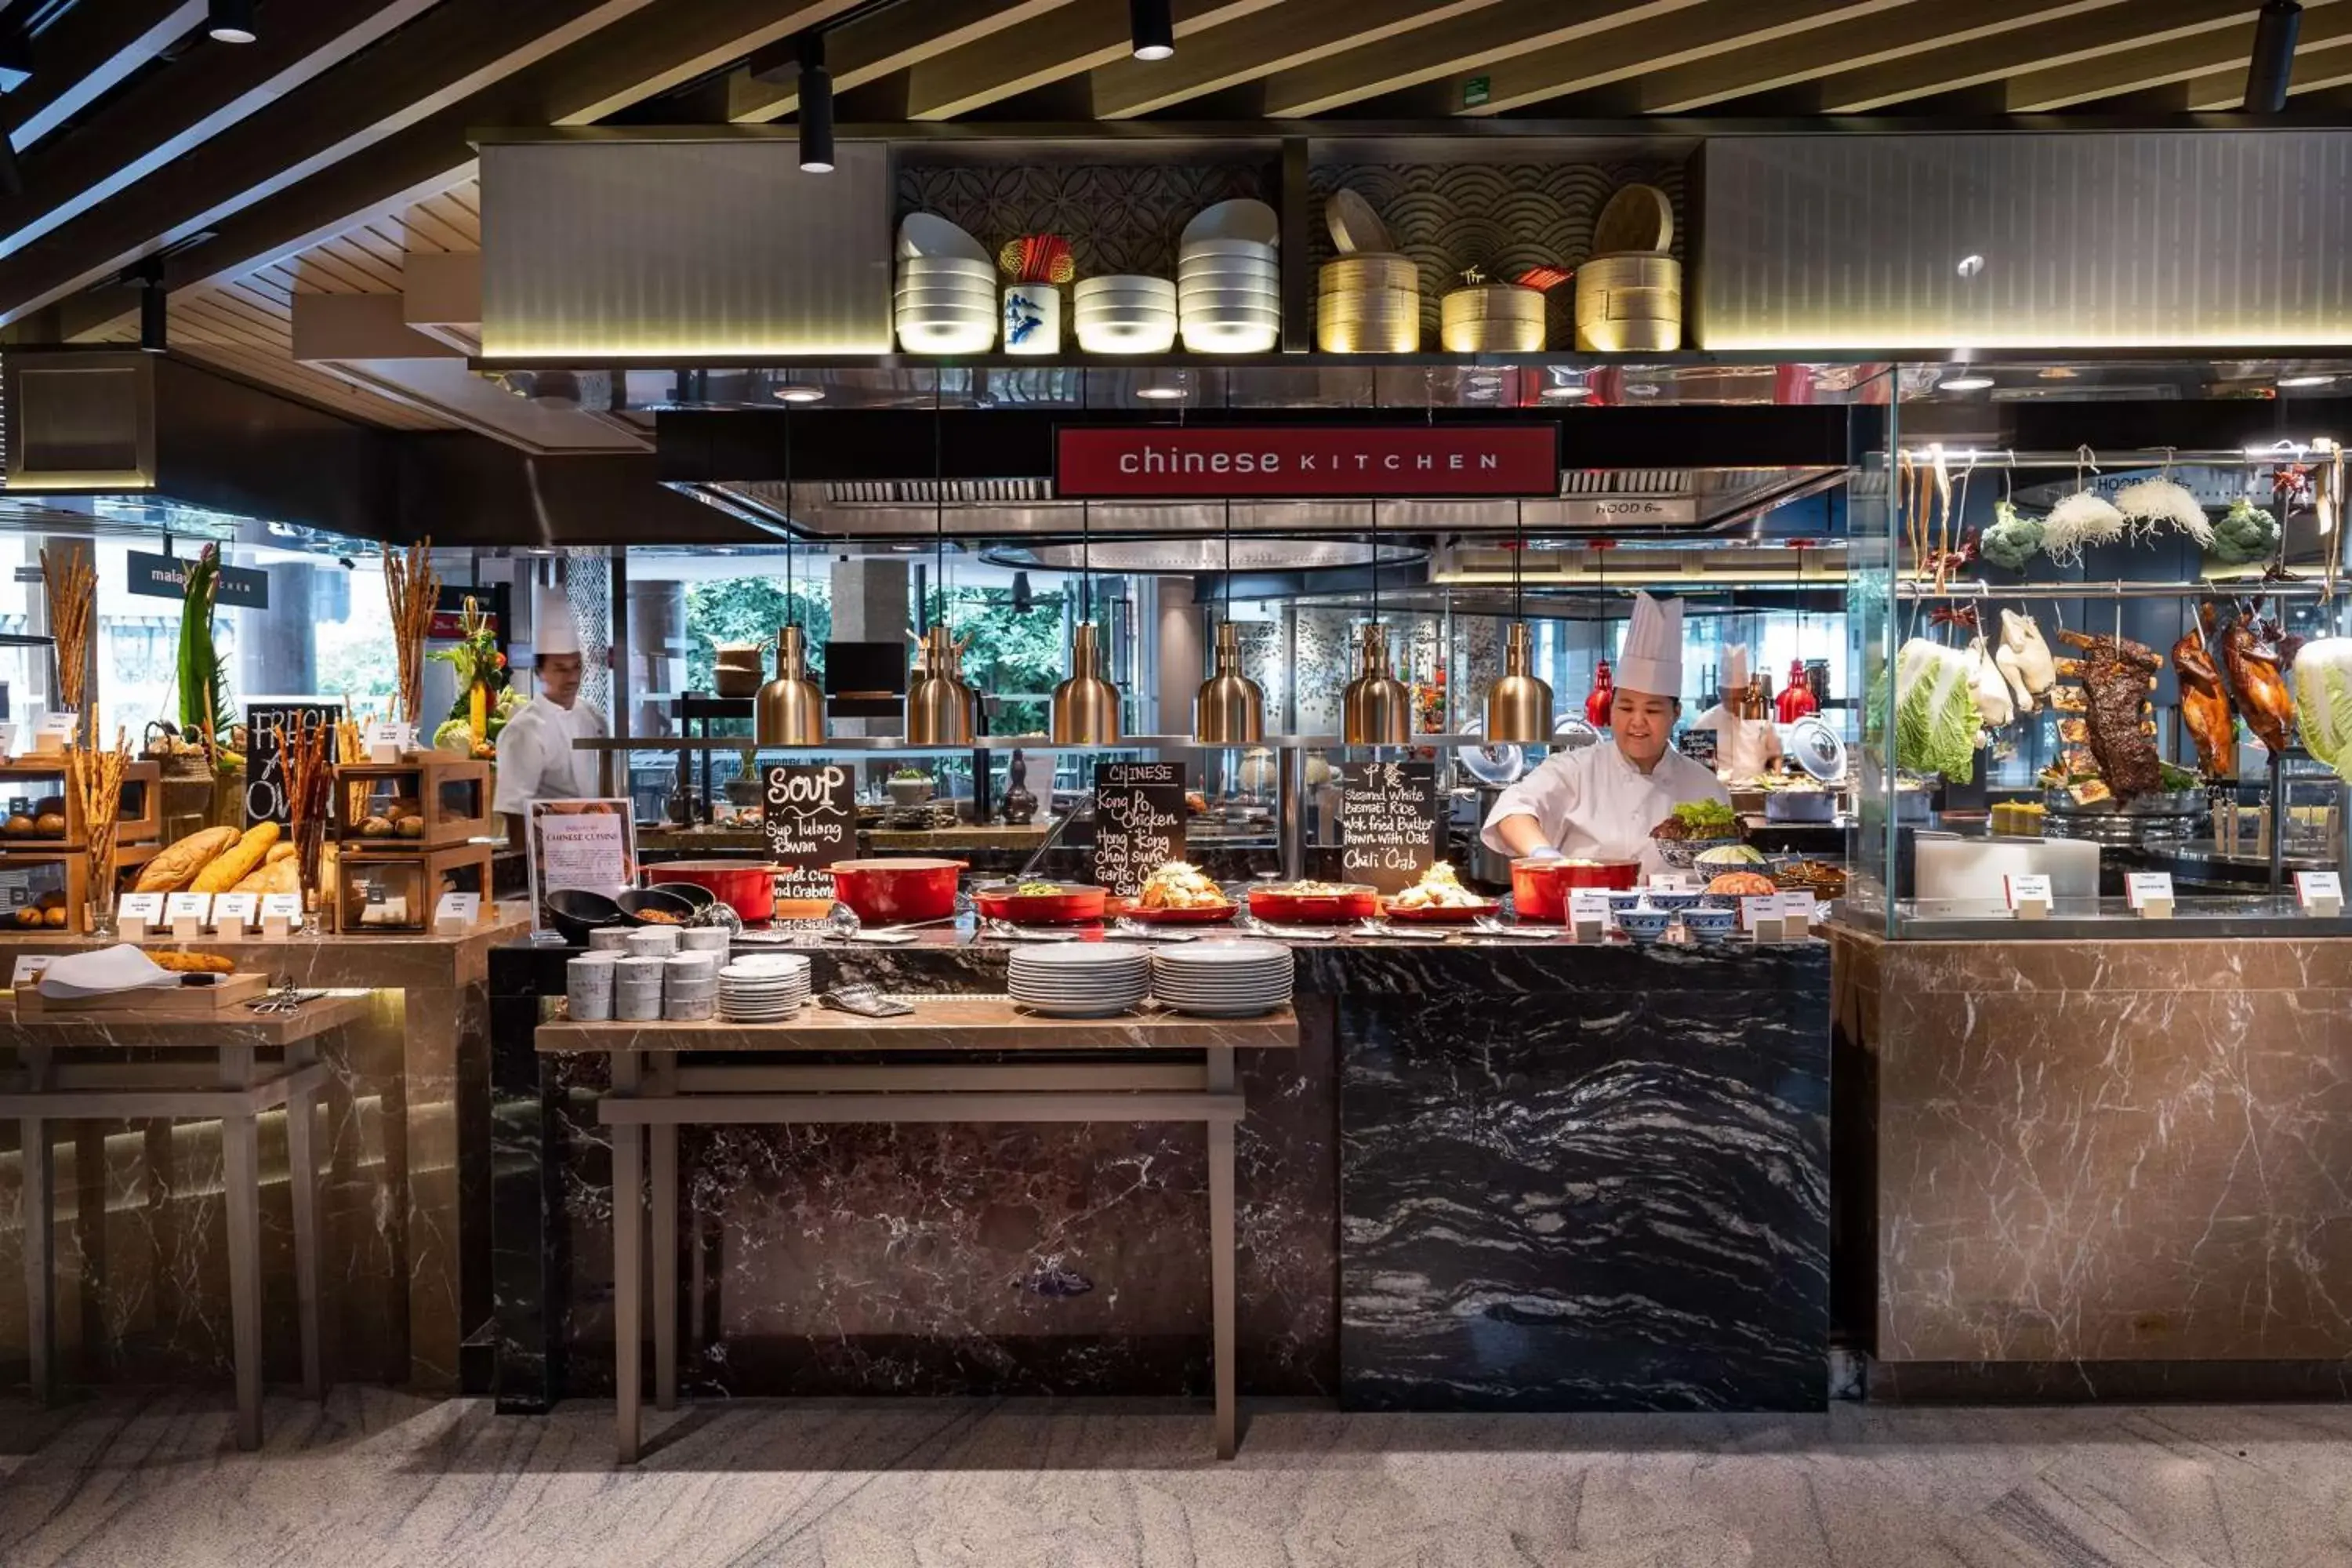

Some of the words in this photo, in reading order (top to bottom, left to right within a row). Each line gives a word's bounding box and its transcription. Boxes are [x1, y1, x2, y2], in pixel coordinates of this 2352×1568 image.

[1119, 446, 1280, 473] chinese
[1301, 455, 1497, 470] KITCHEN
[1109, 764, 1174, 787] CHINESE
[1097, 789, 1129, 820] Kong
[1122, 806, 1179, 833] Chicken
[1096, 826, 1129, 853] Hong
[1095, 865, 1135, 882] Garlic
[775, 883, 791, 898] nd
[1114, 880, 1142, 897] Sau
